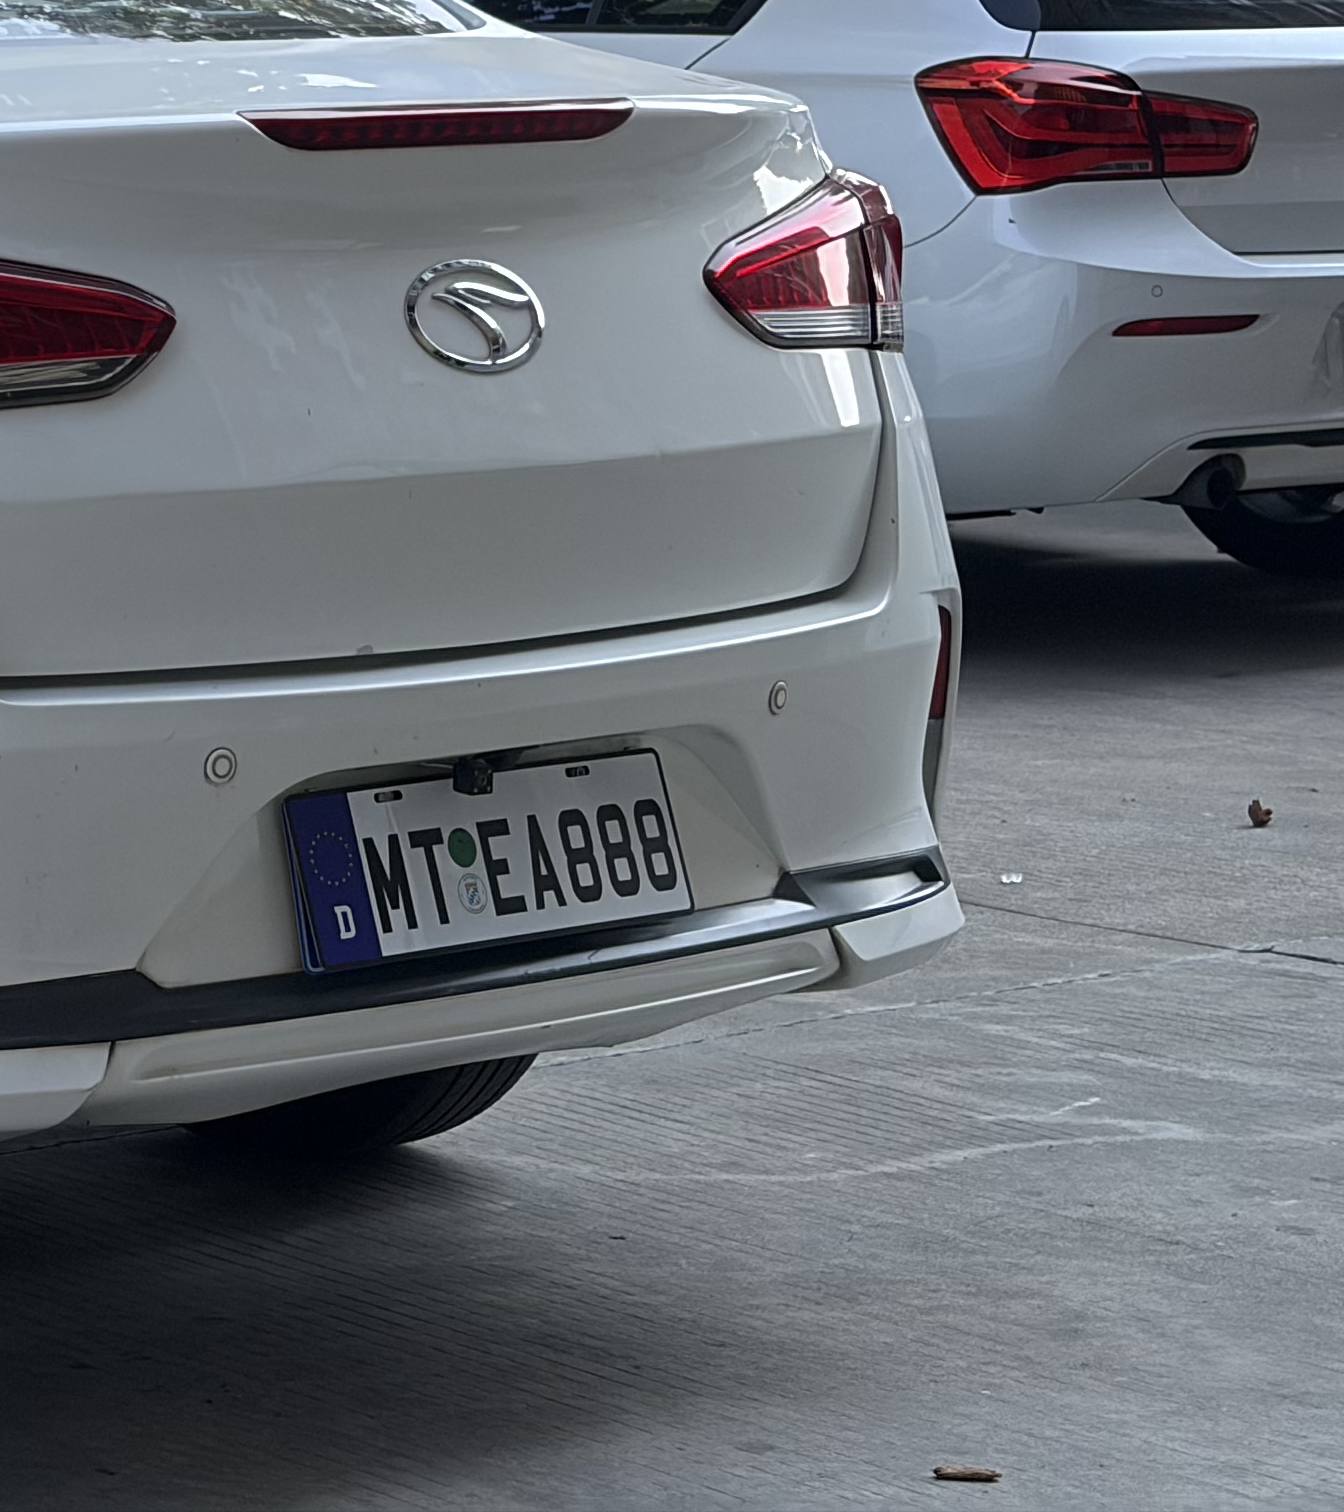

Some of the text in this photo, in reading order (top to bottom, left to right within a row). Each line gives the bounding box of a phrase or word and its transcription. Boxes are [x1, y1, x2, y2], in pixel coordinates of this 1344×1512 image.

[363, 798, 678, 935] MT EA888
[334, 904, 356, 940] D
